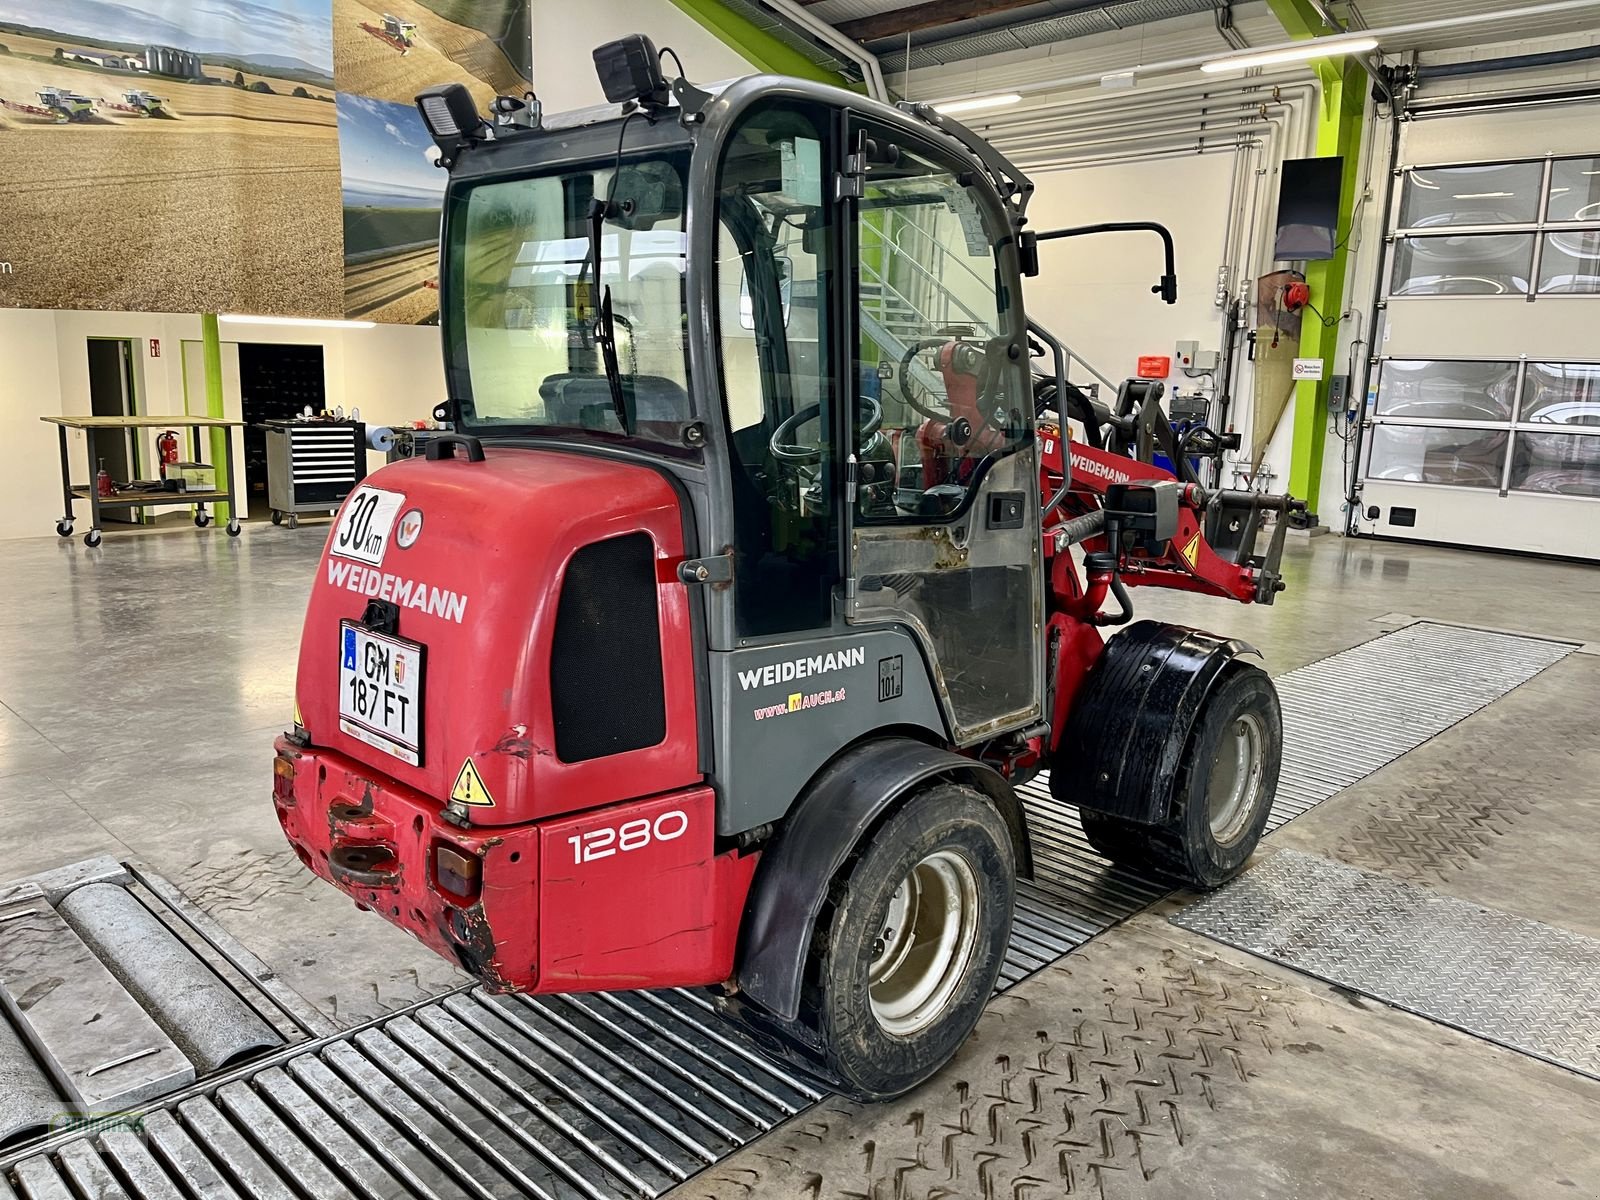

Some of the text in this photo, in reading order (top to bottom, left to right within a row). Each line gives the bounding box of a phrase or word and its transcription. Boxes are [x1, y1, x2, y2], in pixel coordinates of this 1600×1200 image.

[1069, 452, 1130, 484] WEIDEMANN
[340, 492, 383, 556] 30 km
[327, 558, 468, 624] WEIDEMANN
[346, 655, 354, 668] A
[364, 641, 390, 686] GM
[737, 646, 865, 691] WEIDEMANN
[350, 675, 410, 735] 187 FT
[753, 687, 847, 721] www.MAUCH.at
[880, 675, 895, 698] 101
[567, 810, 689, 865] 1280
